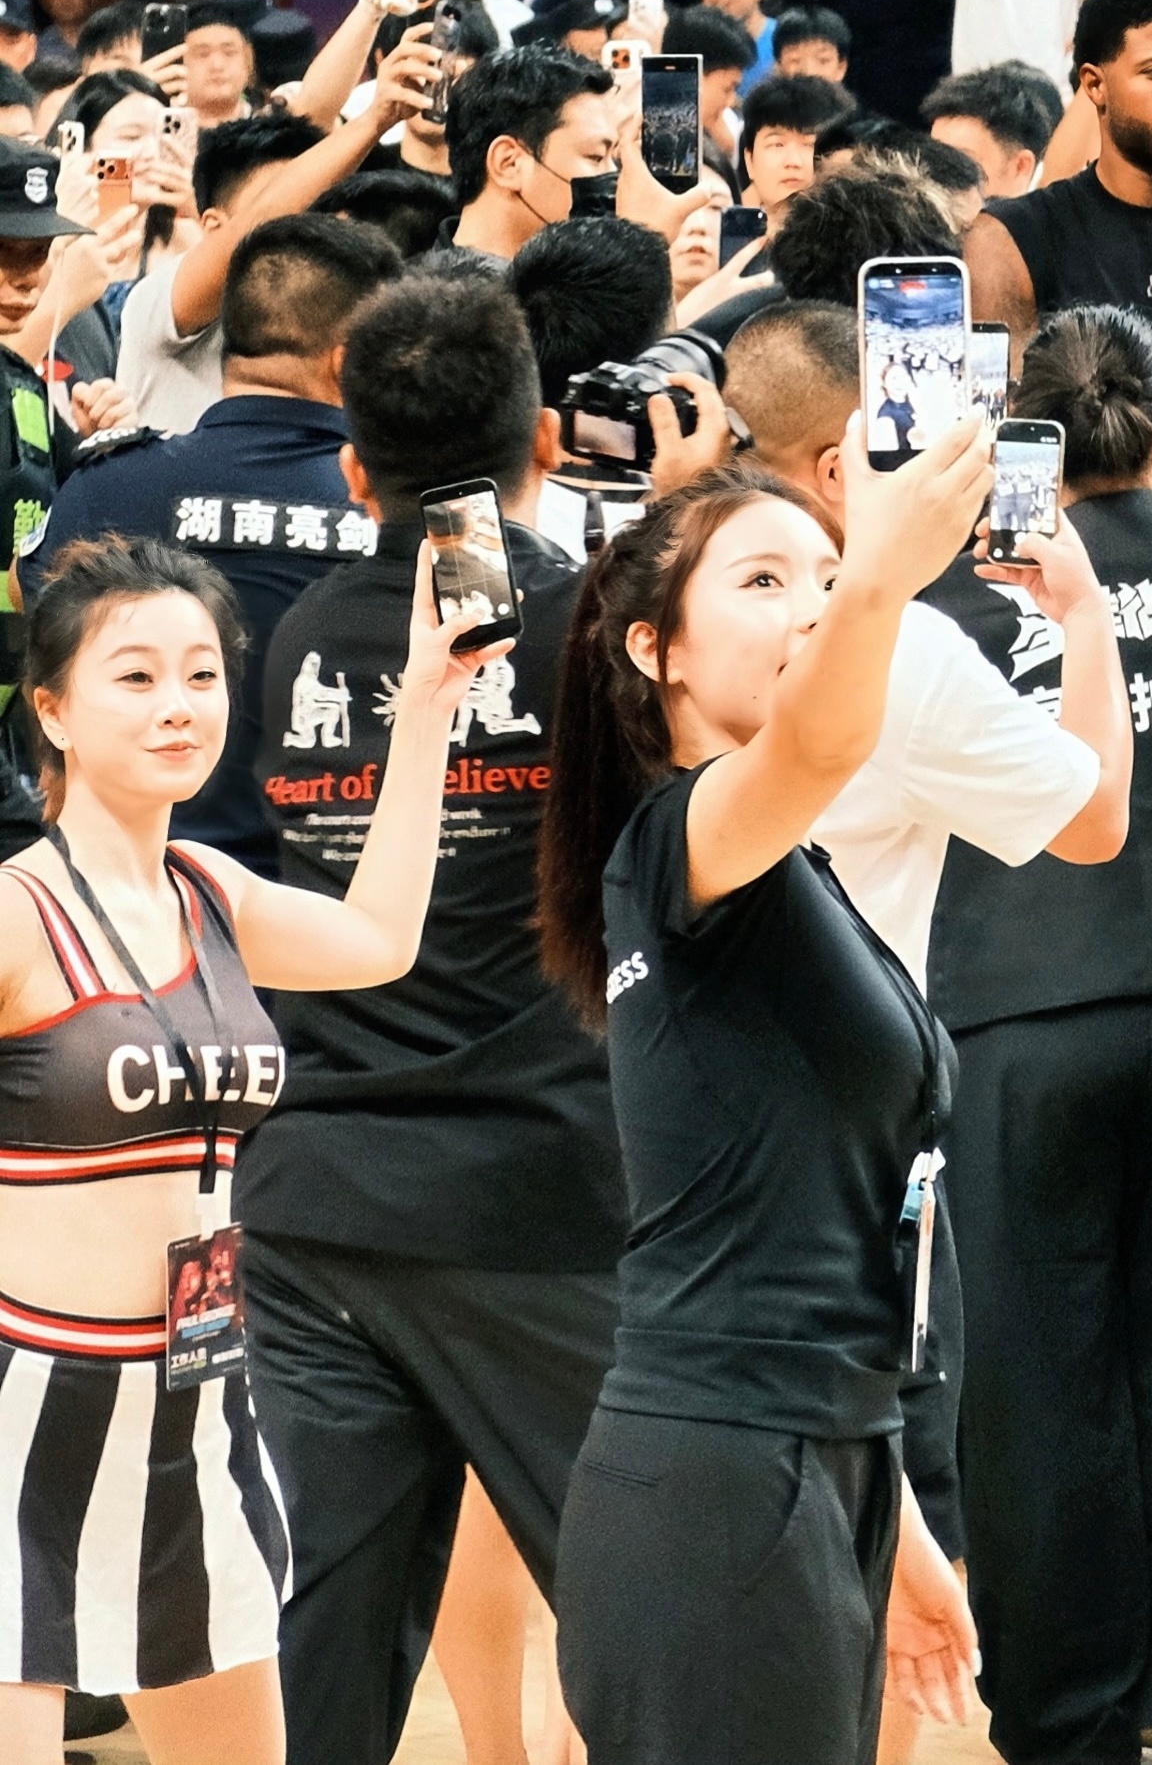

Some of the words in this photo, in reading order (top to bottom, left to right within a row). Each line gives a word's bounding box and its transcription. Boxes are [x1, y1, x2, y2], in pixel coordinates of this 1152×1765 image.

[175, 497, 379, 557] 湖南亮剑
[340, 763, 378, 801] of
[443, 758, 550, 795] elieve
[107, 1044, 286, 1114] CHEE
